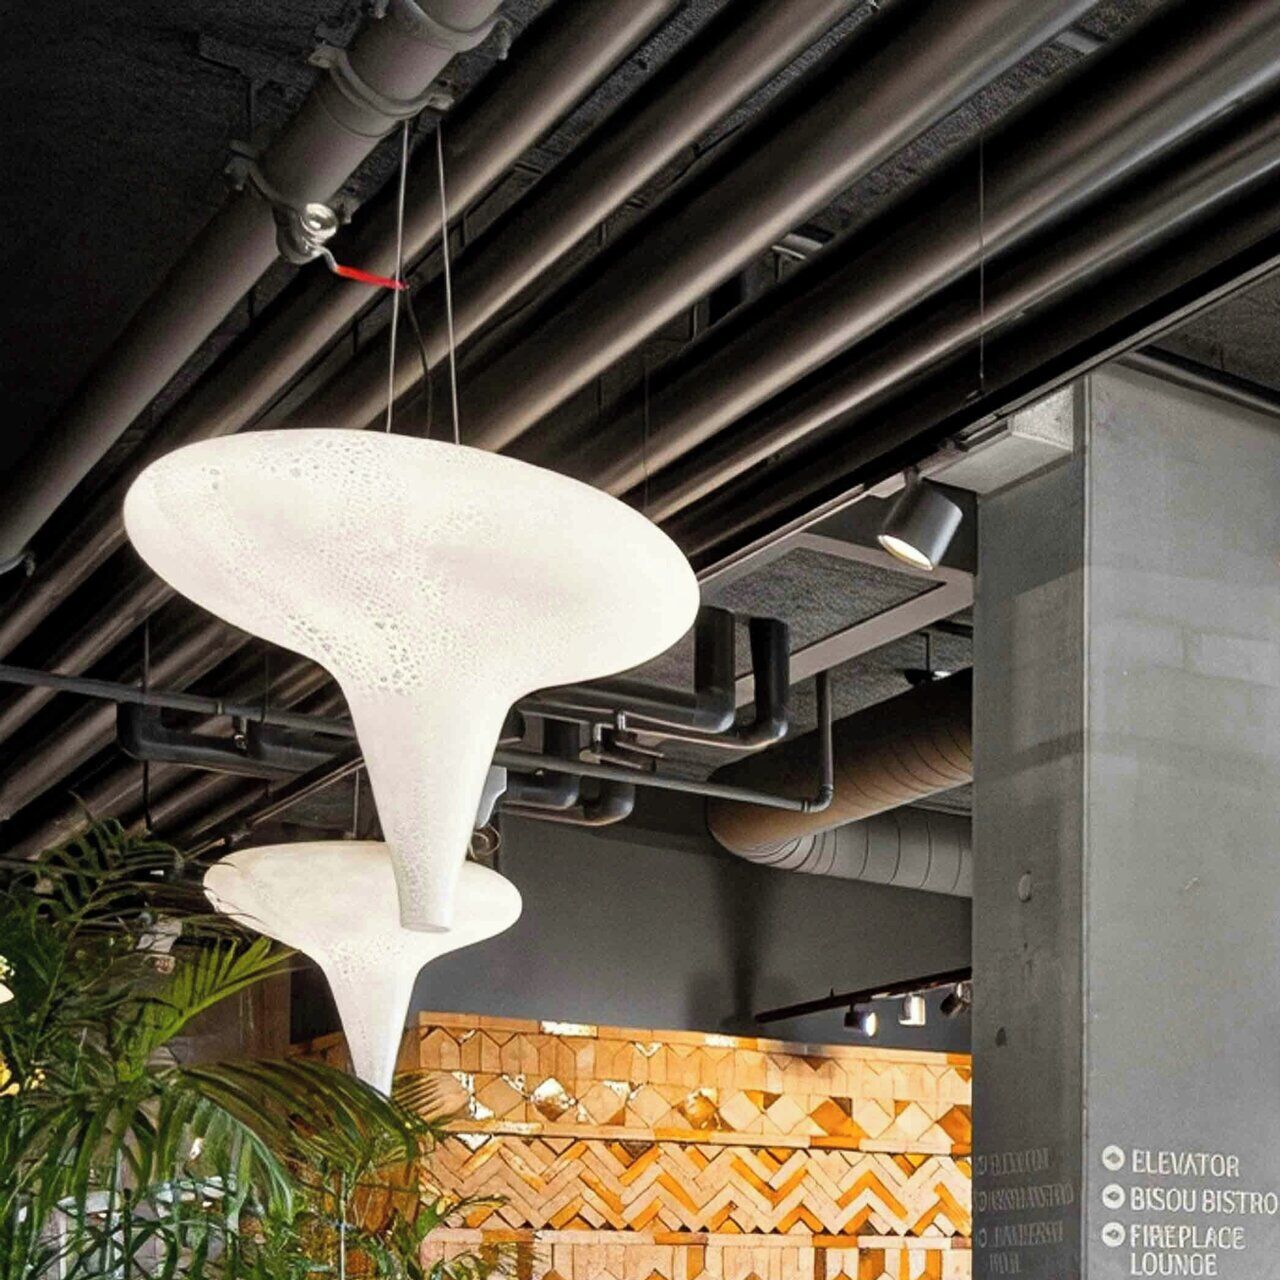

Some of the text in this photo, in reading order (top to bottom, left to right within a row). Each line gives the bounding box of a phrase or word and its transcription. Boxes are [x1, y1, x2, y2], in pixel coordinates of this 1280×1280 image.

[1132, 1149, 1240, 1177] ELEVATOR
[1130, 1186, 1279, 1215] BISOU BISTRO
[1130, 1224, 1247, 1250] FIREPLACE
